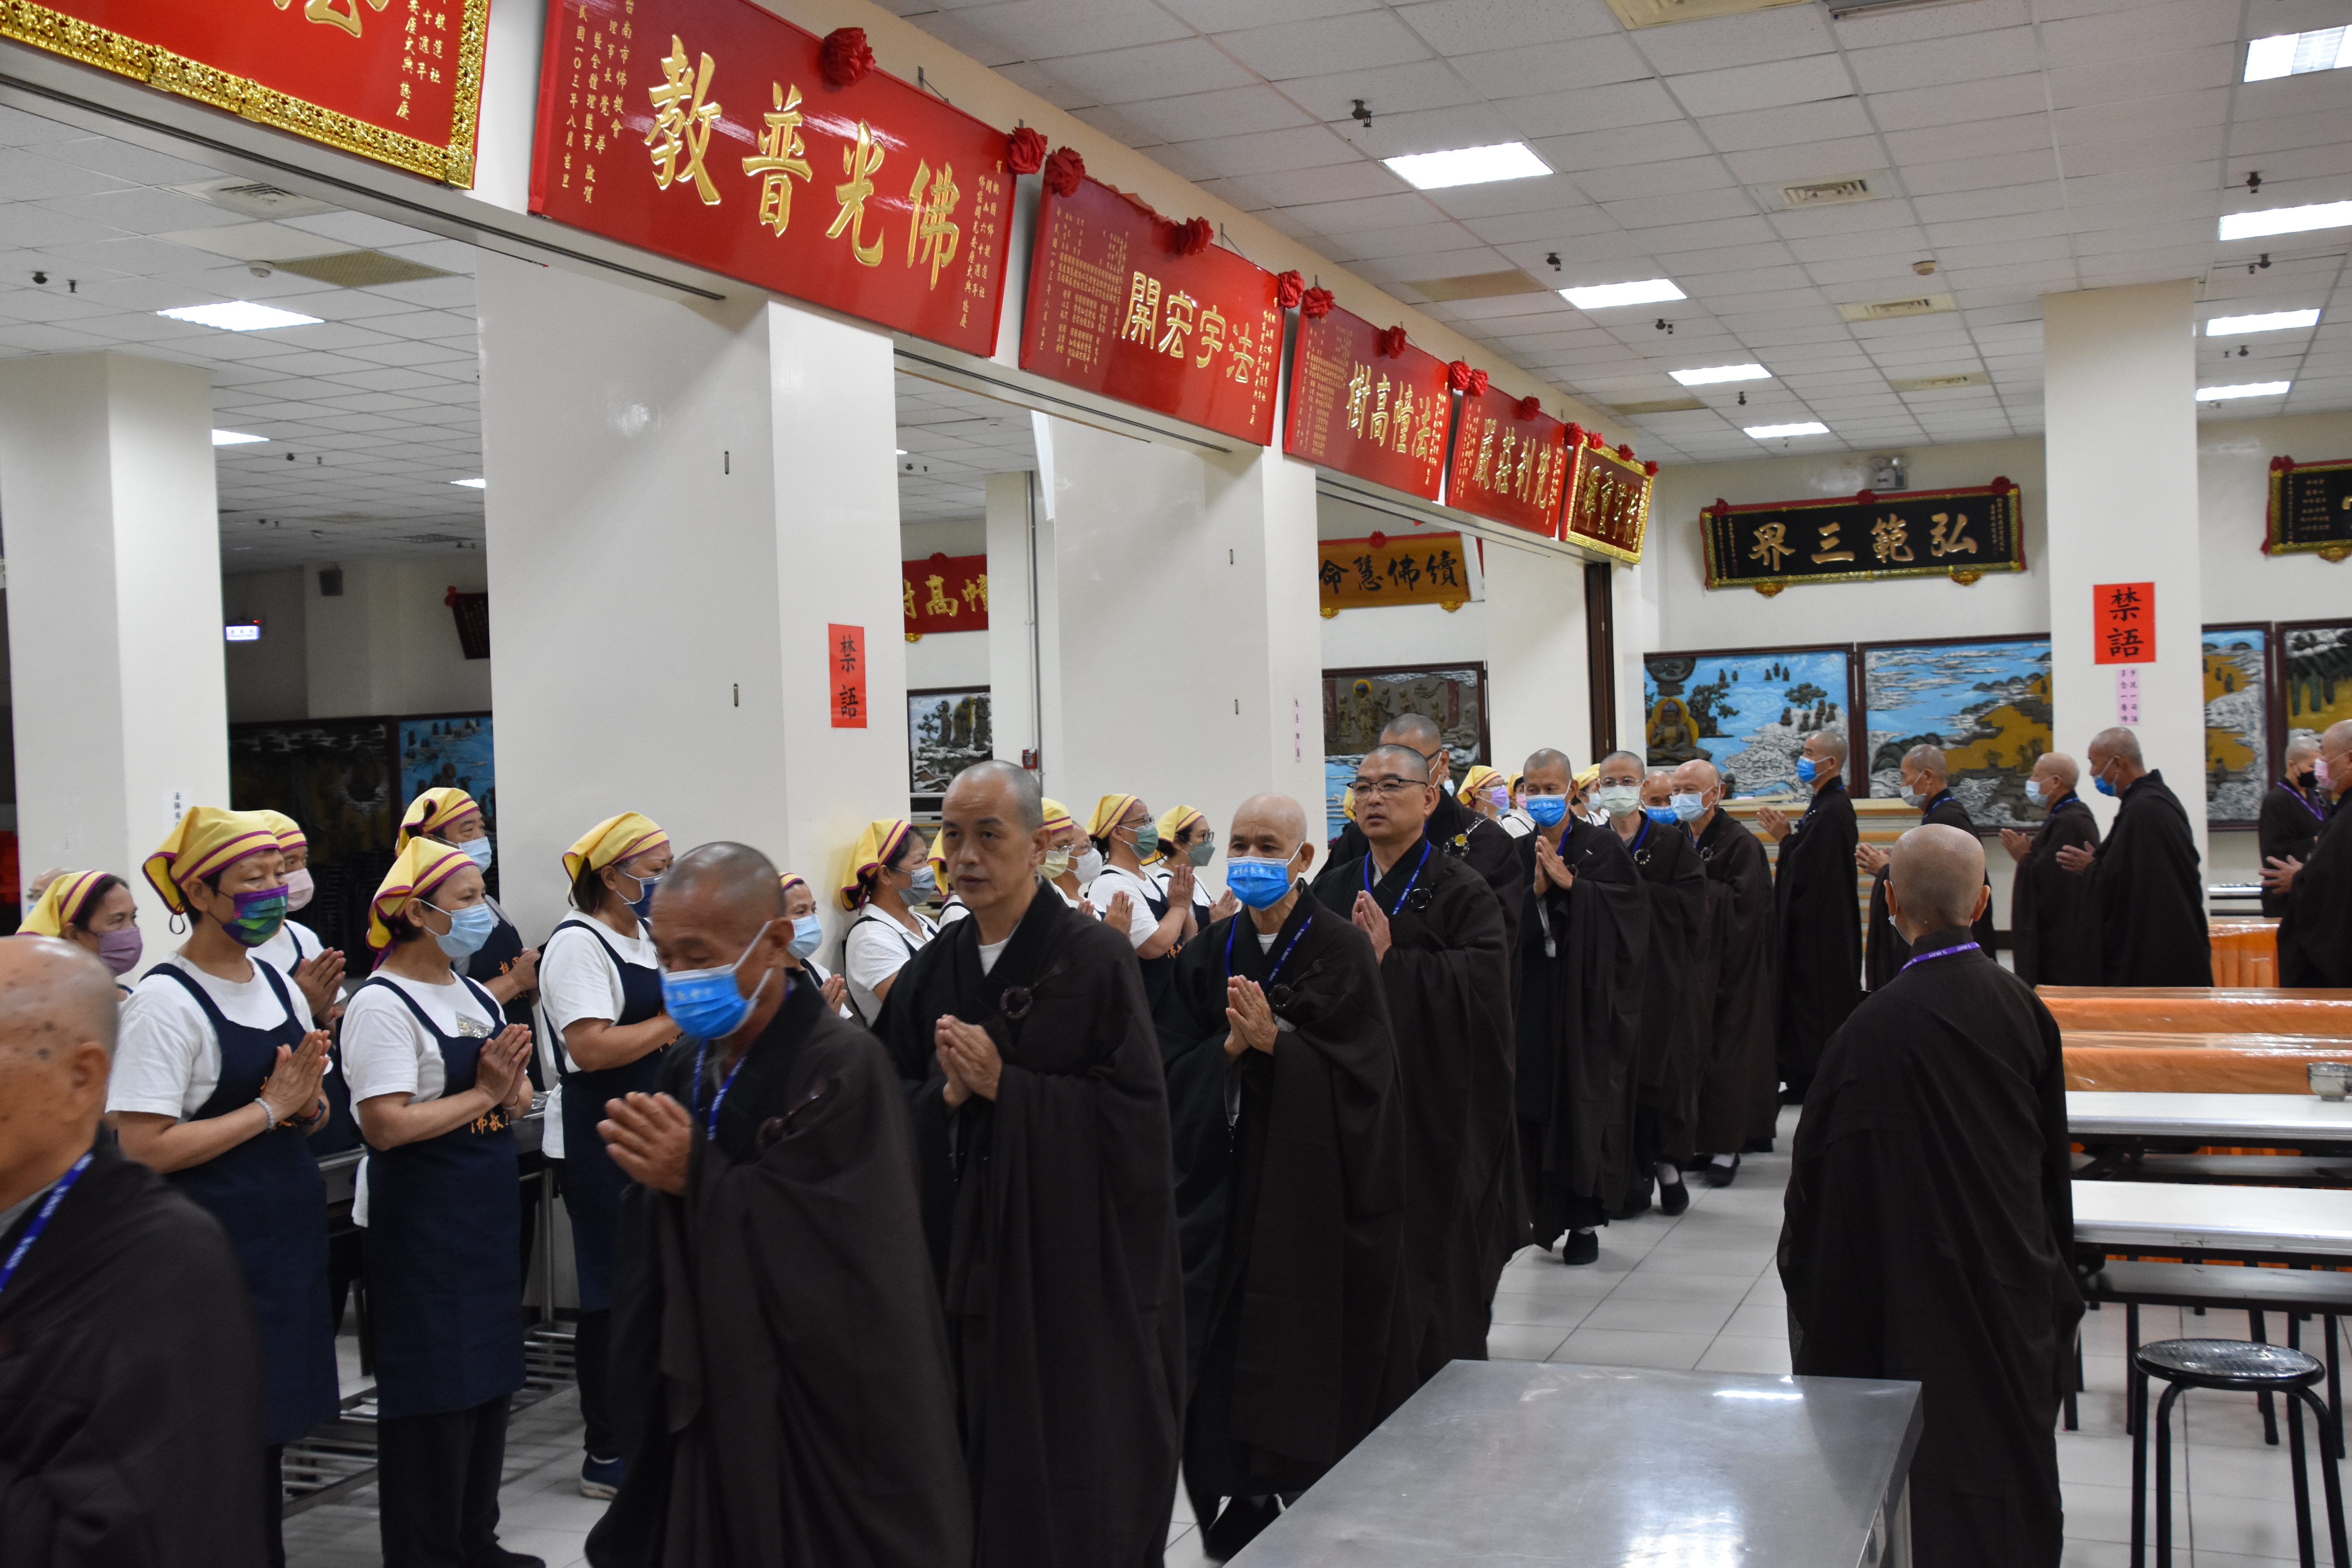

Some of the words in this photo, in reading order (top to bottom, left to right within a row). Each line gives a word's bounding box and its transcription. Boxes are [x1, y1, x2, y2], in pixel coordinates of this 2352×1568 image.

[644, 34, 960, 290] 佛光普教
[1345, 360, 1431, 462] 法幢高樹
[1319, 550, 1458, 594] 續佛慧命
[1748, 513, 1978, 571] 弘範三界
[2107, 587, 2144, 657] 禁語
[839, 634, 858, 719] 禁語
[471, 1111, 509, 1134] 佛教
